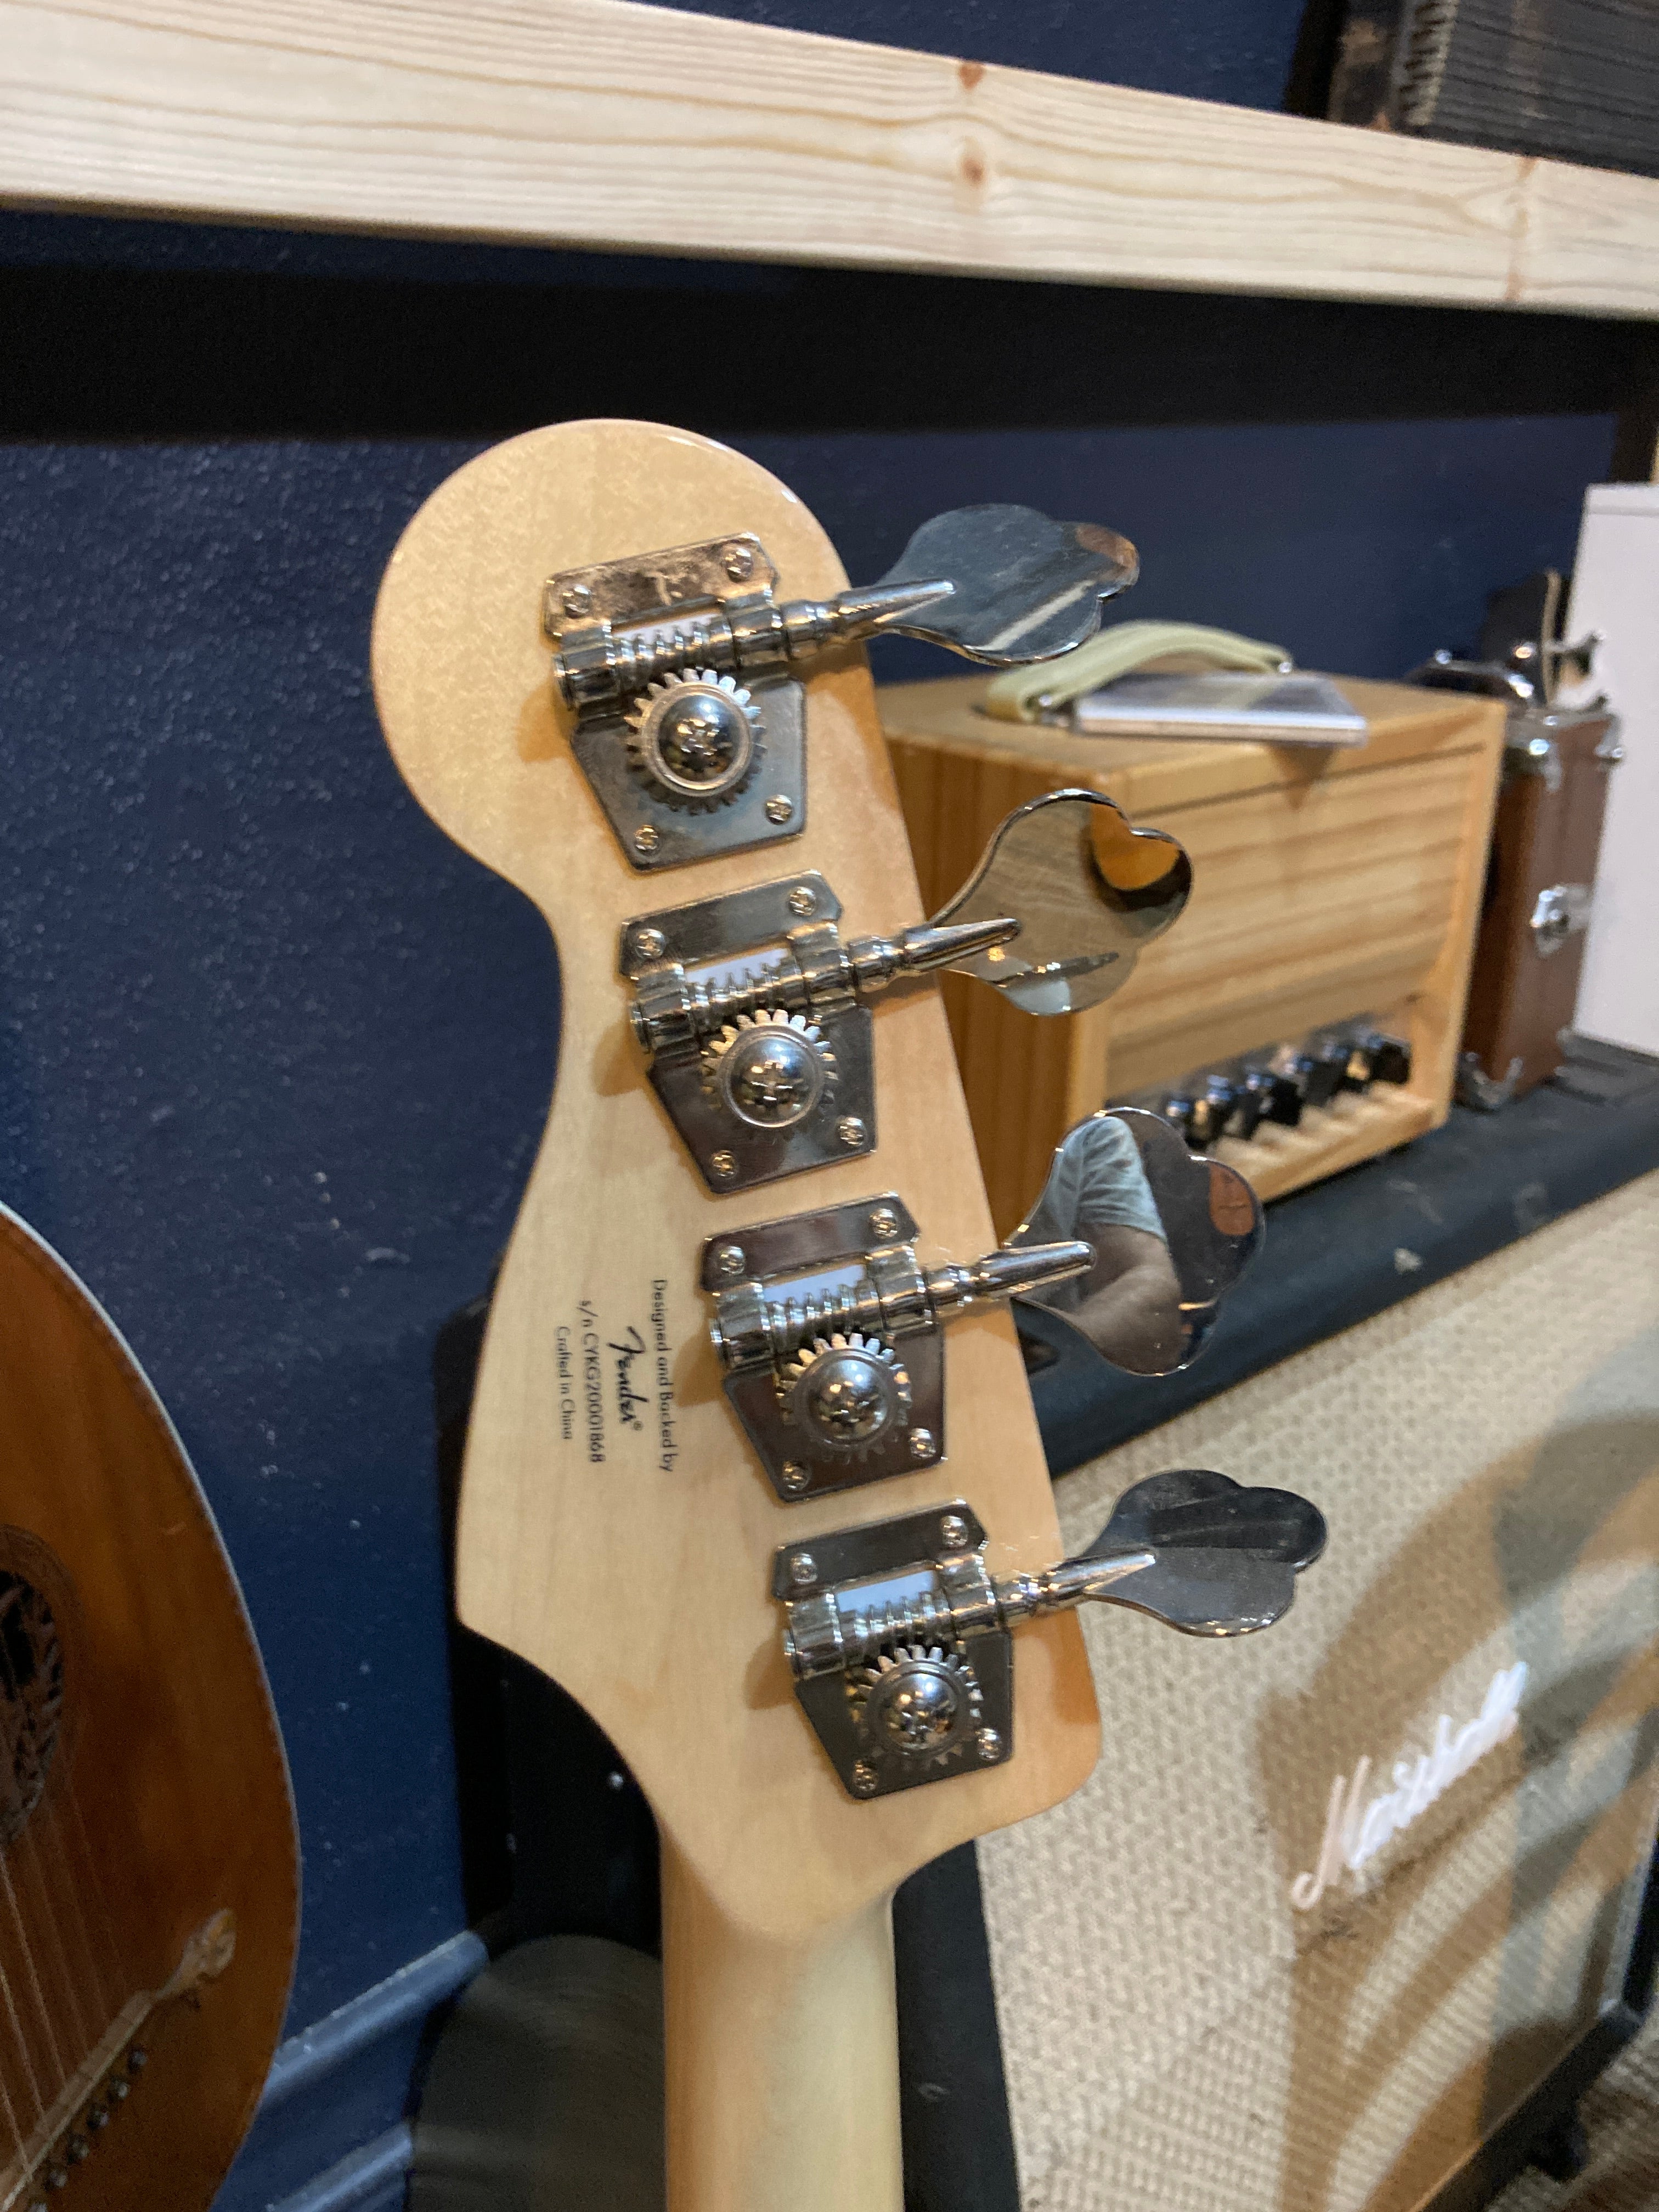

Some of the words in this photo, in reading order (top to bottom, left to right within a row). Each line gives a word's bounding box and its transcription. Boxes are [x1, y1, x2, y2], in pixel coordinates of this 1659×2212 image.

[576, 1300, 599, 1328] s/n
[651, 1279, 672, 1351] Designed
[556, 1326, 573, 1378] Crafted
[560, 1383, 571, 1394] in
[657, 1357, 673, 1386] and
[561, 1399, 575, 1440] China
[659, 1391, 677, 1448] Backed
[658, 1454, 679, 1471] by
